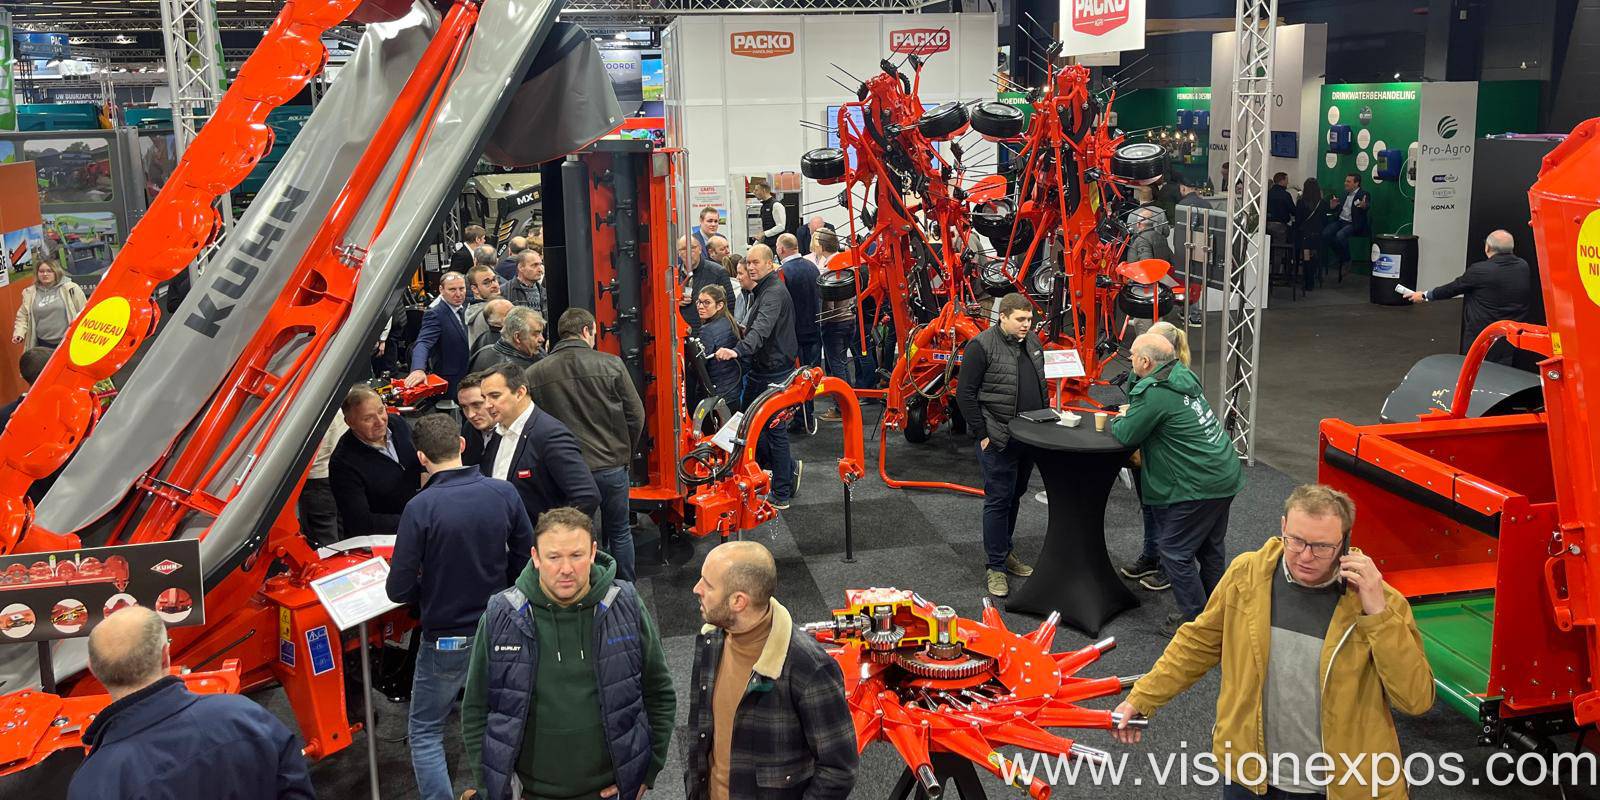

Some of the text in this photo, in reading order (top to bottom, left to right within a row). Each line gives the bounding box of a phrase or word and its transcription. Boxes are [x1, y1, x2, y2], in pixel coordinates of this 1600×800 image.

[734, 34, 791, 49] PACKO
[893, 32, 948, 47] PACKO
[1331, 91, 1416, 100] DRINKWATERBEHANDELING
[1421, 144, 1471, 156] Pro-Agro
[184, 185, 310, 339] KUHN
[81, 318, 124, 337] NOUVEAU
[80, 331, 110, 347] NIEUW
